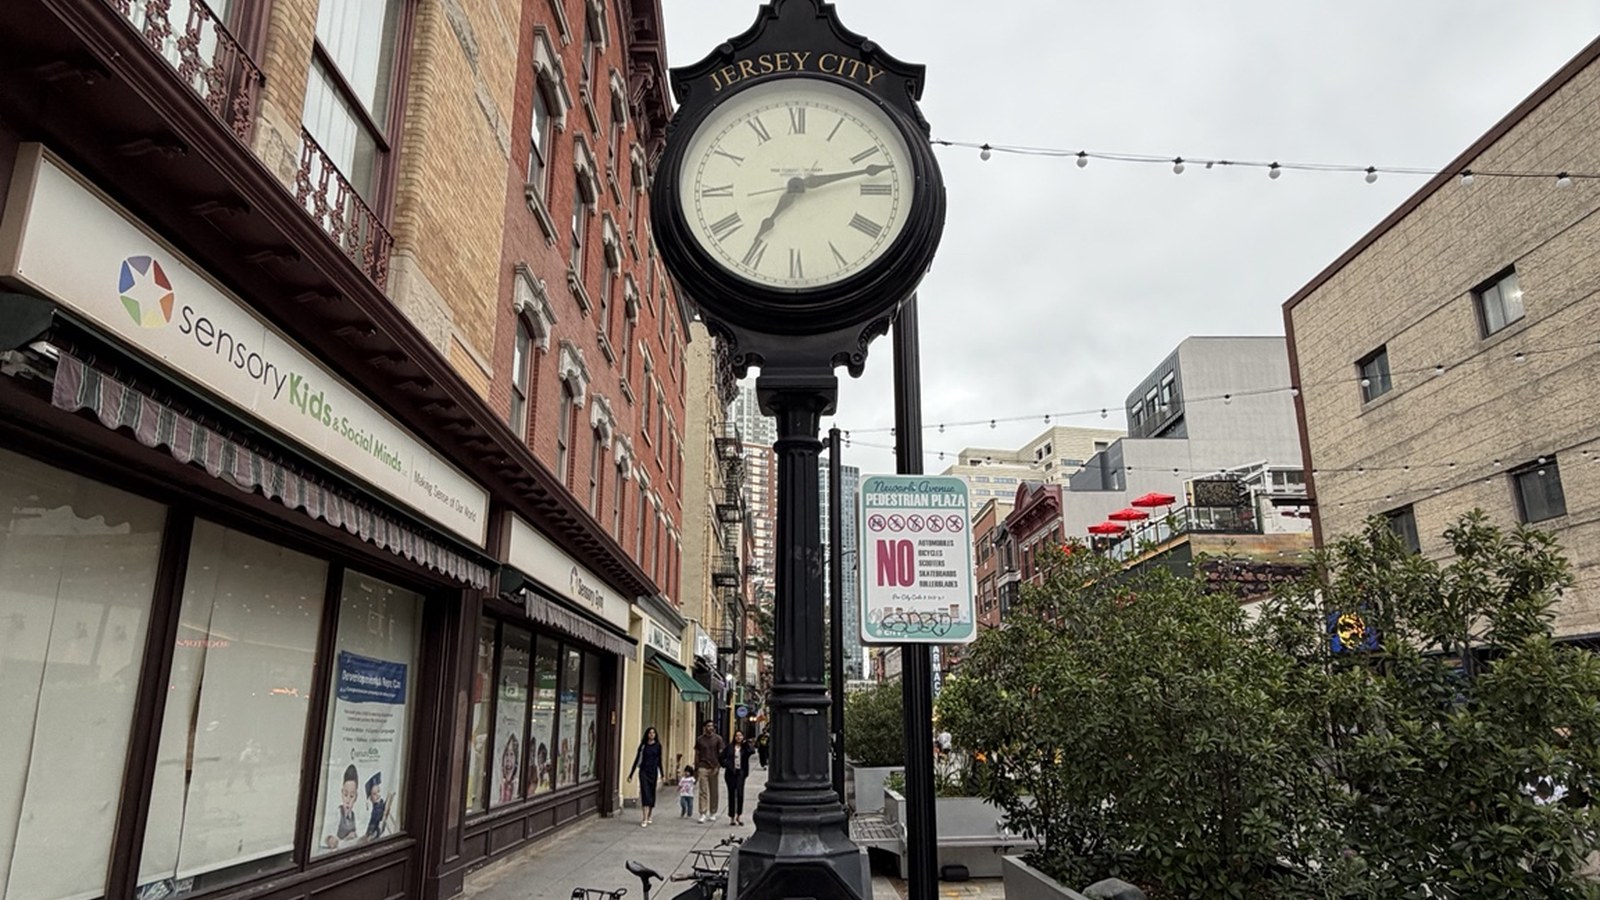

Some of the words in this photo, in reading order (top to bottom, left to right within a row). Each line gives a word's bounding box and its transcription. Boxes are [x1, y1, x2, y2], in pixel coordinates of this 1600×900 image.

[709, 52, 811, 92] JERSEY
[818, 53, 885, 86] CITY
[746, 116, 772, 147] XI
[786, 107, 806, 135] XII
[340, 416, 373, 453] Social
[373, 439, 402, 473] Minds
[919, 480, 956, 494] Avenue
[865, 493, 929, 507] PEDESTRIAN
[931, 494, 966, 508] PLAZA
[918, 539, 954, 547] AUTOMOBILES
[918, 549, 943, 557] BICYCLES
[876, 539, 915, 587] NO
[919, 580, 958, 588] ROLLERBLADES
